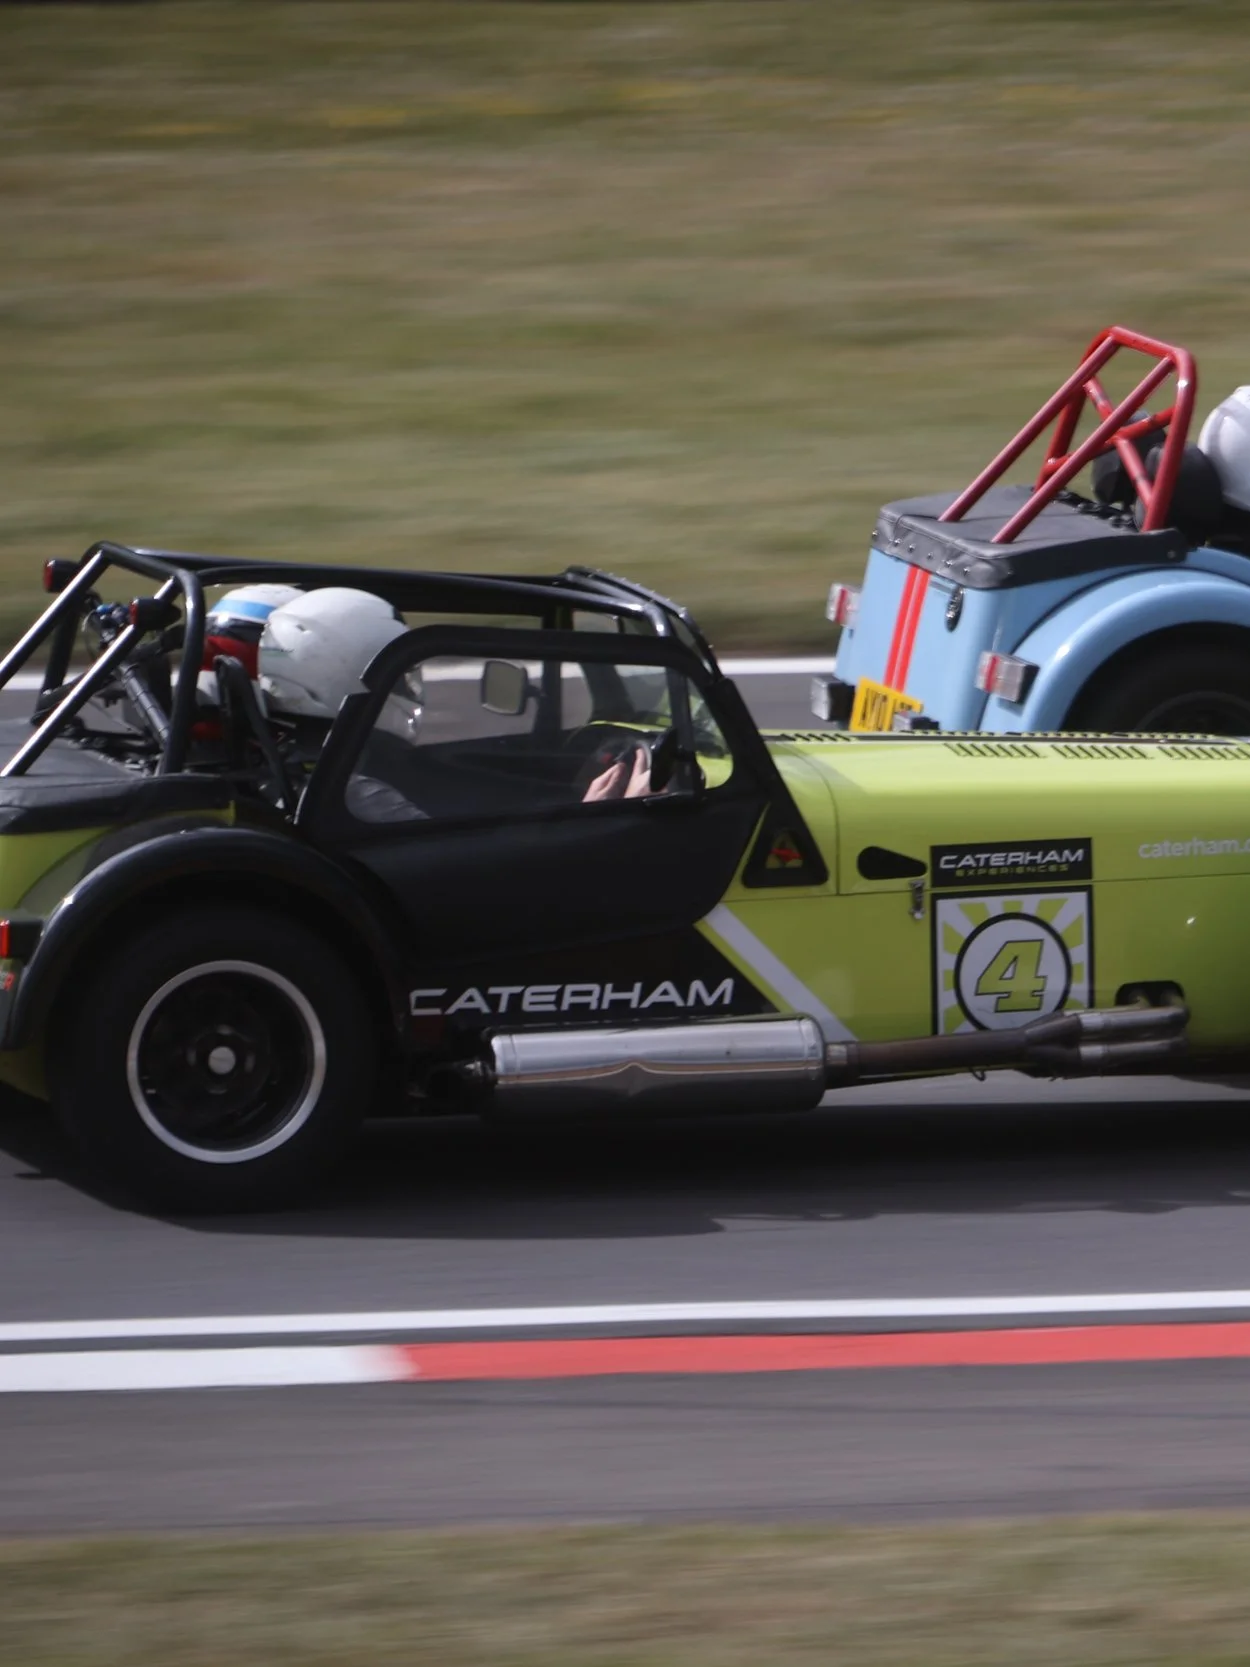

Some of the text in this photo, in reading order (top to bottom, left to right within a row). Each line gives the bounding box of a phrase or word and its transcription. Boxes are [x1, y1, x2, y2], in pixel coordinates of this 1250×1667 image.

[938, 848, 1085, 869] CATERHAM
[955, 864, 1069, 877] EXPERIENCES
[974, 938, 1048, 1014] 4
[409, 978, 735, 1016] CATERHAM
